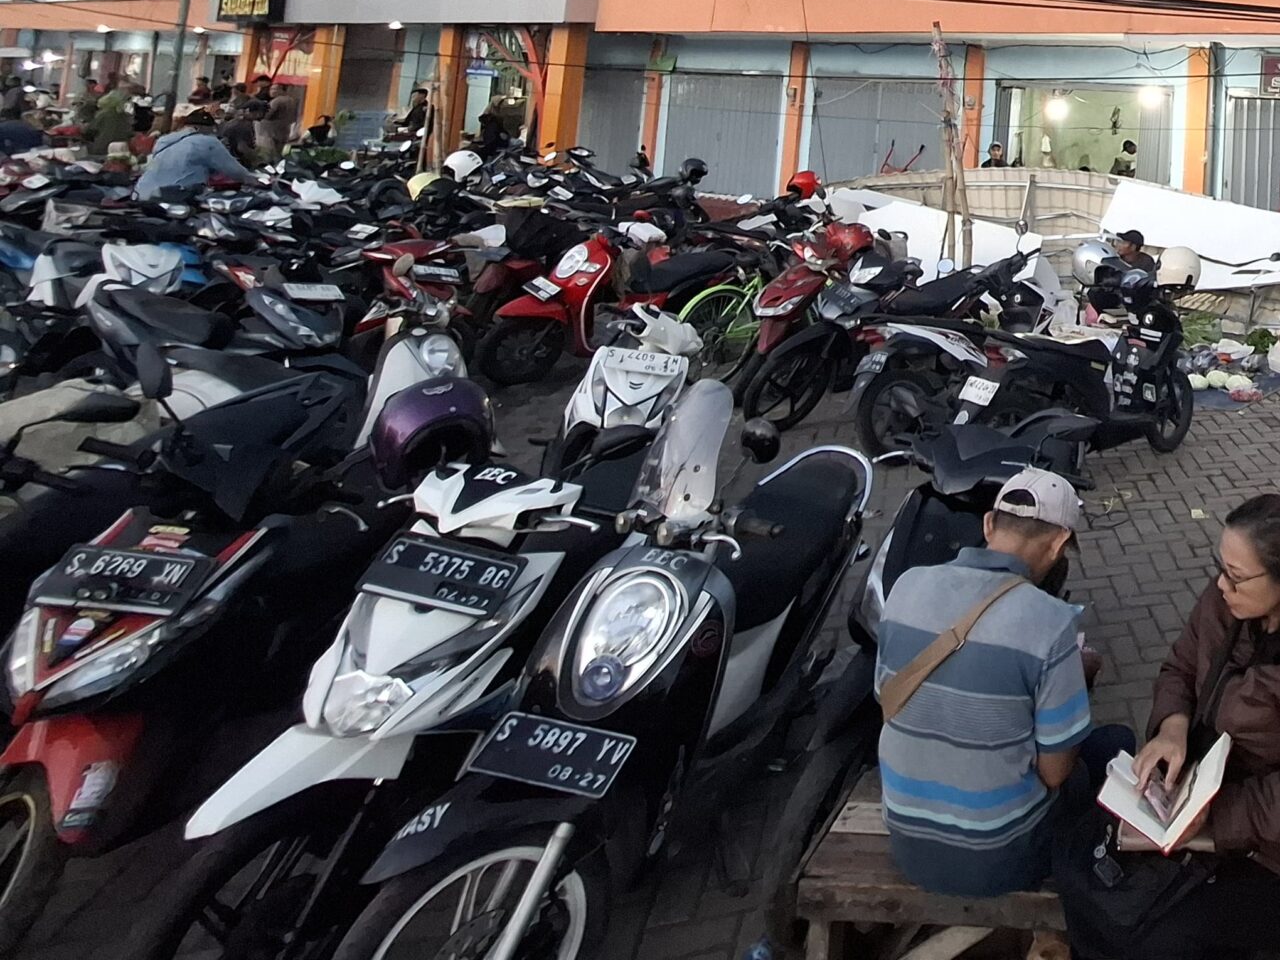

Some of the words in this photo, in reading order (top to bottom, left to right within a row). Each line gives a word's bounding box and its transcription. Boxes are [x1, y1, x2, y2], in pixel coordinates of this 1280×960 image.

[473, 467, 518, 485] EEC
[64, 553, 86, 576] S
[386, 544, 405, 564] S
[418, 551, 476, 580] 5375
[641, 548, 688, 570] EEC
[496, 718, 518, 741] S
[527, 723, 588, 756] 5897
[595, 738, 630, 765] YV
